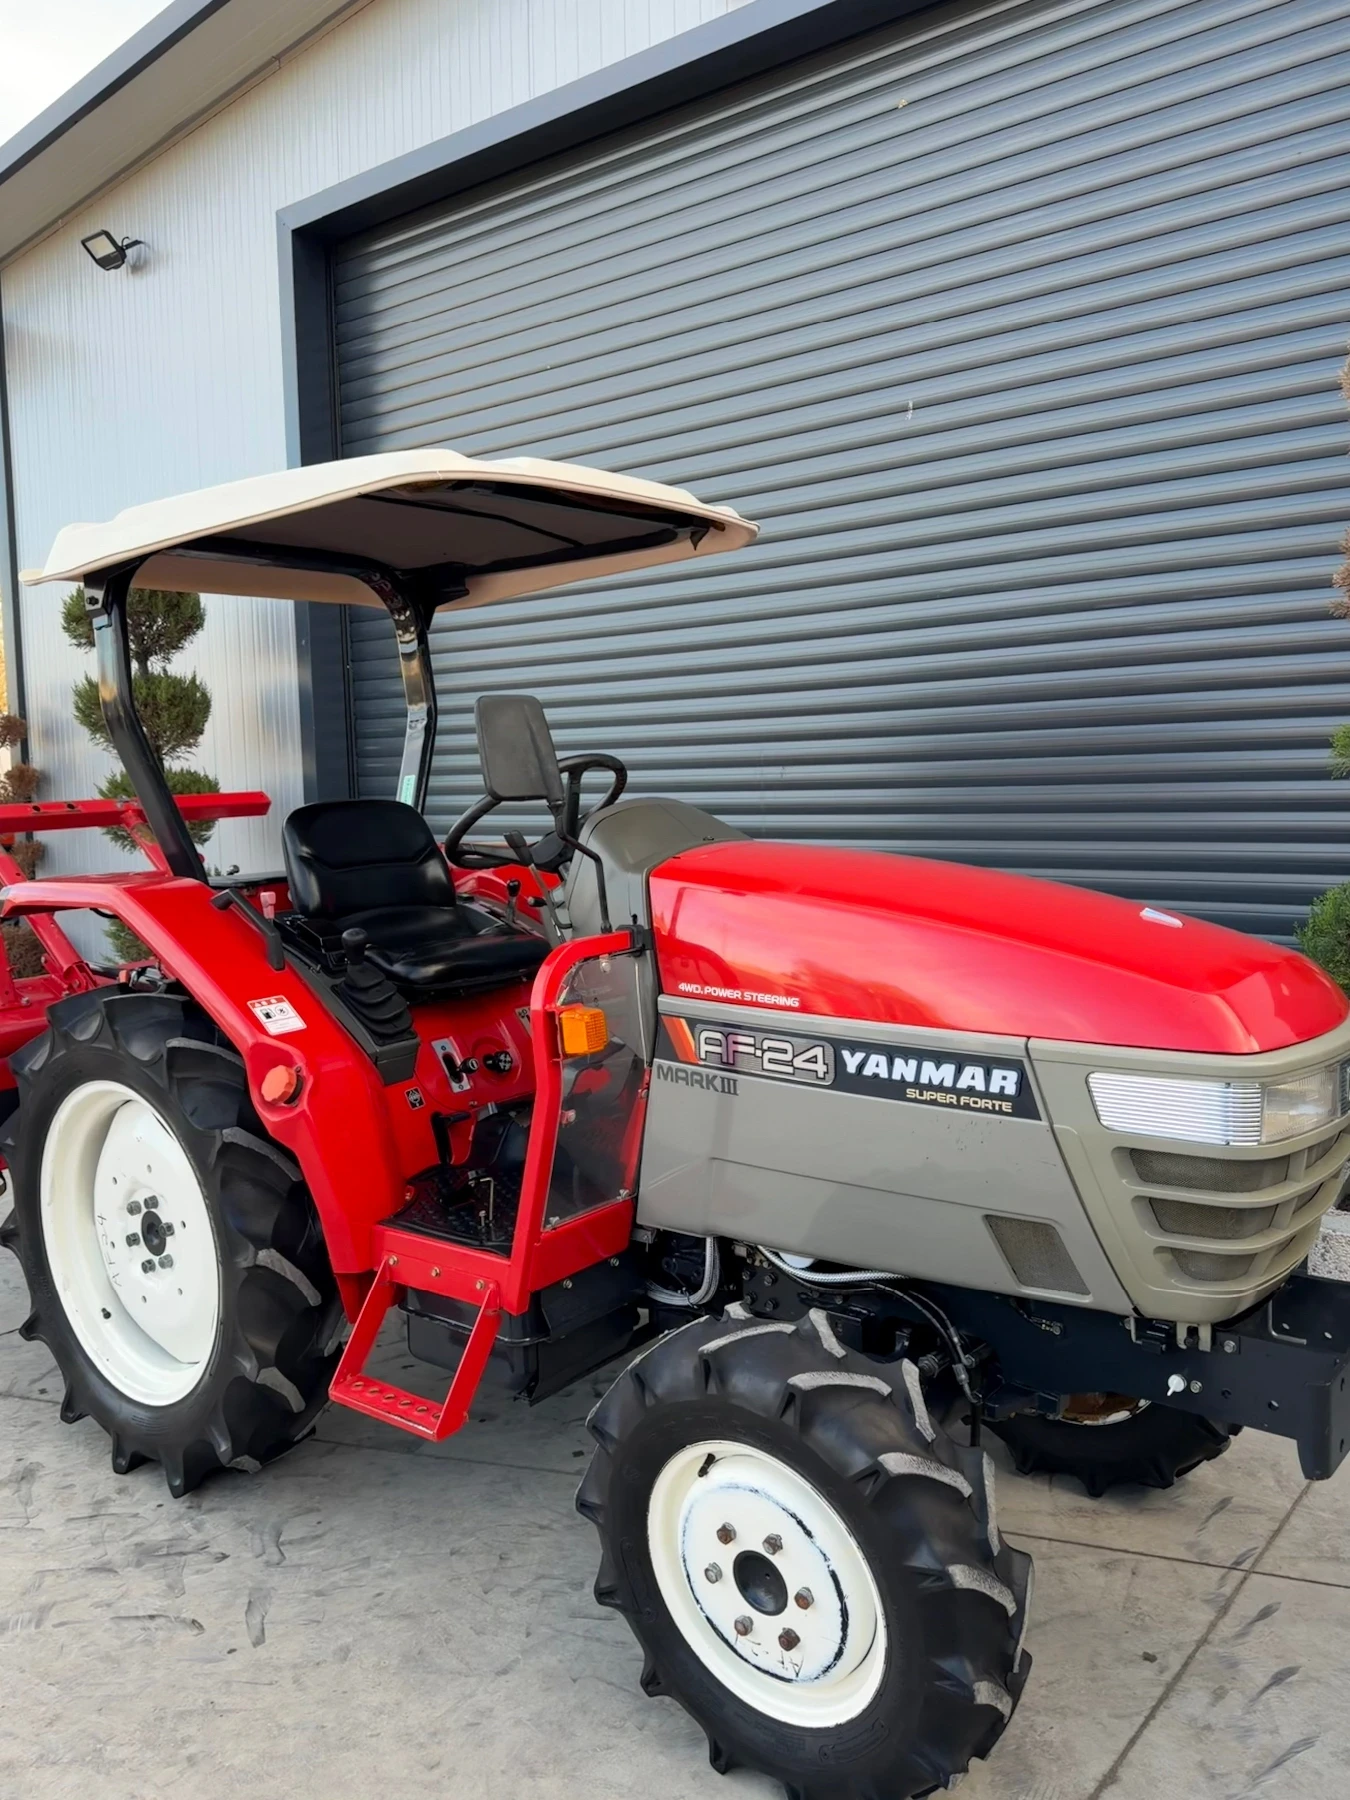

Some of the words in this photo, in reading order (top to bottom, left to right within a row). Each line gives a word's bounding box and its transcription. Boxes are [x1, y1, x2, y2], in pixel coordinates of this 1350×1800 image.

[704, 986, 741, 999] POWER
[743, 991, 799, 1007] STEERING
[699, 1030, 828, 1080] AF-24
[841, 1049, 1019, 1096] YANMAR
[906, 1088, 957, 1105] SUPER
[960, 1096, 1012, 1112] FORTE
